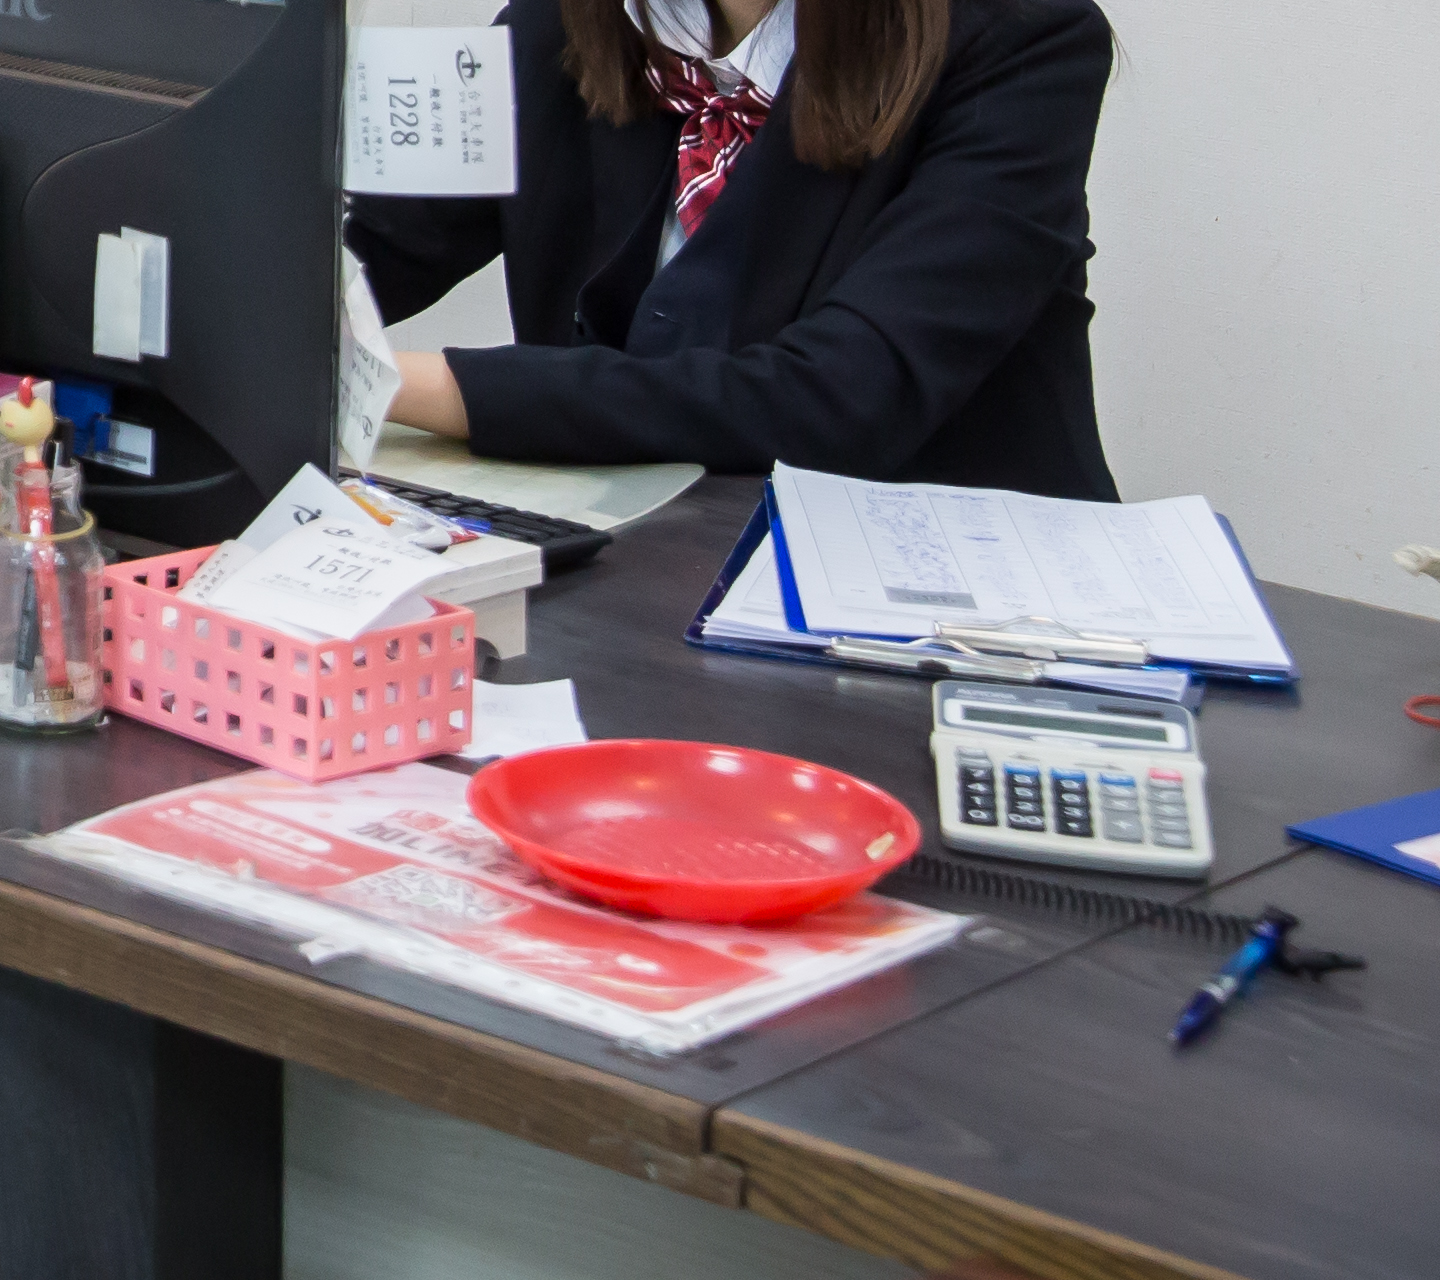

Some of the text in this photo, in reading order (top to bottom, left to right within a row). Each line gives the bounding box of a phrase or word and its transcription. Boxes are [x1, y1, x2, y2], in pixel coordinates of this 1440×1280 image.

[387, 76, 421, 147] 1228
[469, 90, 485, 165] 台灣大車隊
[303, 553, 375, 584] 1571
